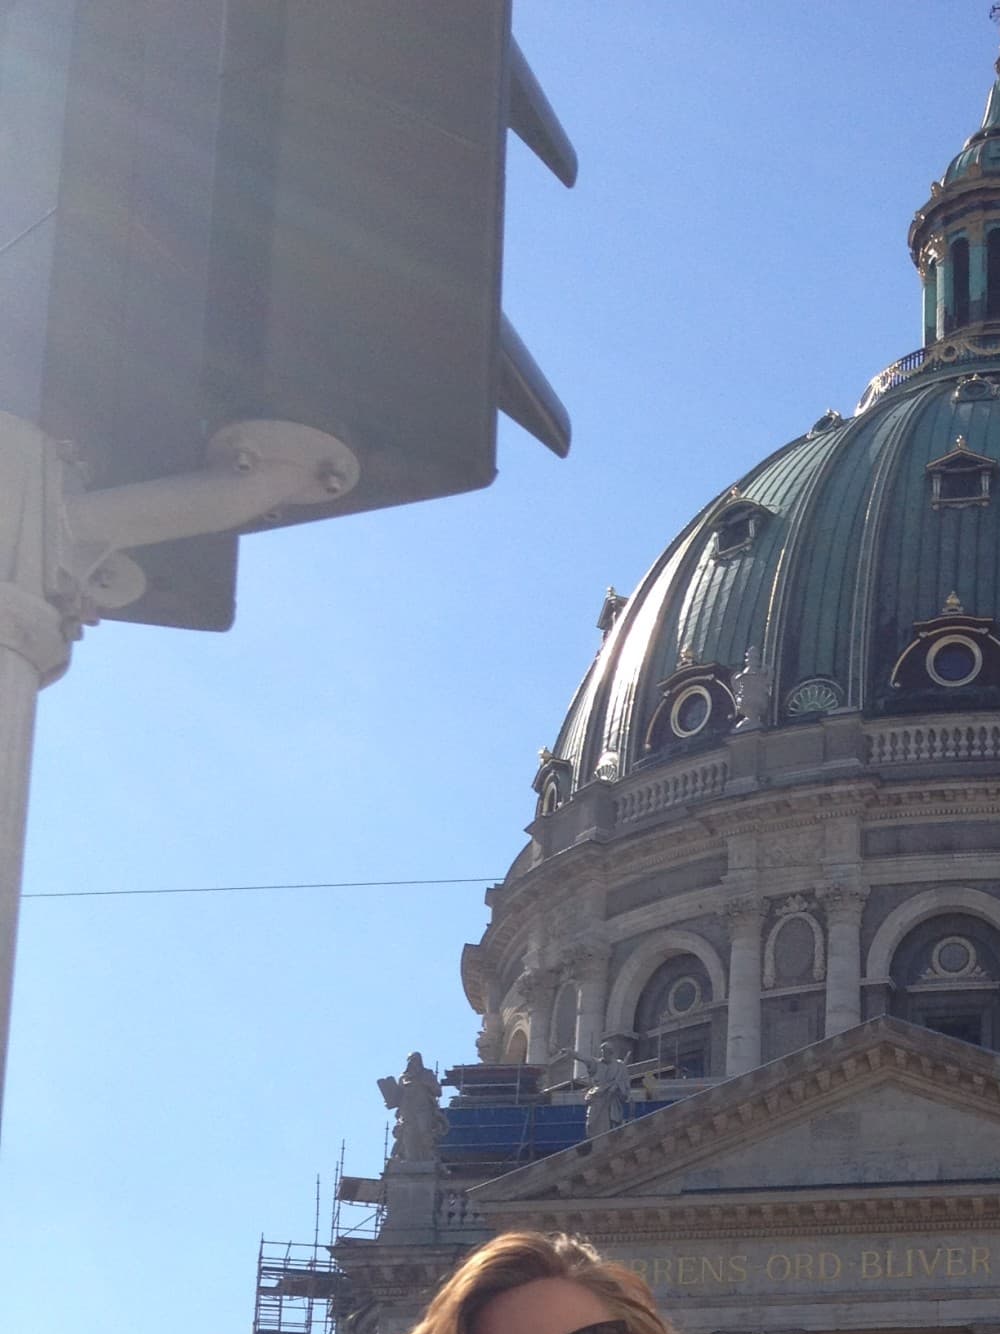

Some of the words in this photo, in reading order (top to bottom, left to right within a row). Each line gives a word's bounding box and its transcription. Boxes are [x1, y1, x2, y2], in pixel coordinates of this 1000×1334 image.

[607, 1255, 748, 1286] RRENS
[766, 1252, 842, 1283] ORD
[860, 1246, 992, 1279] BLIVER
